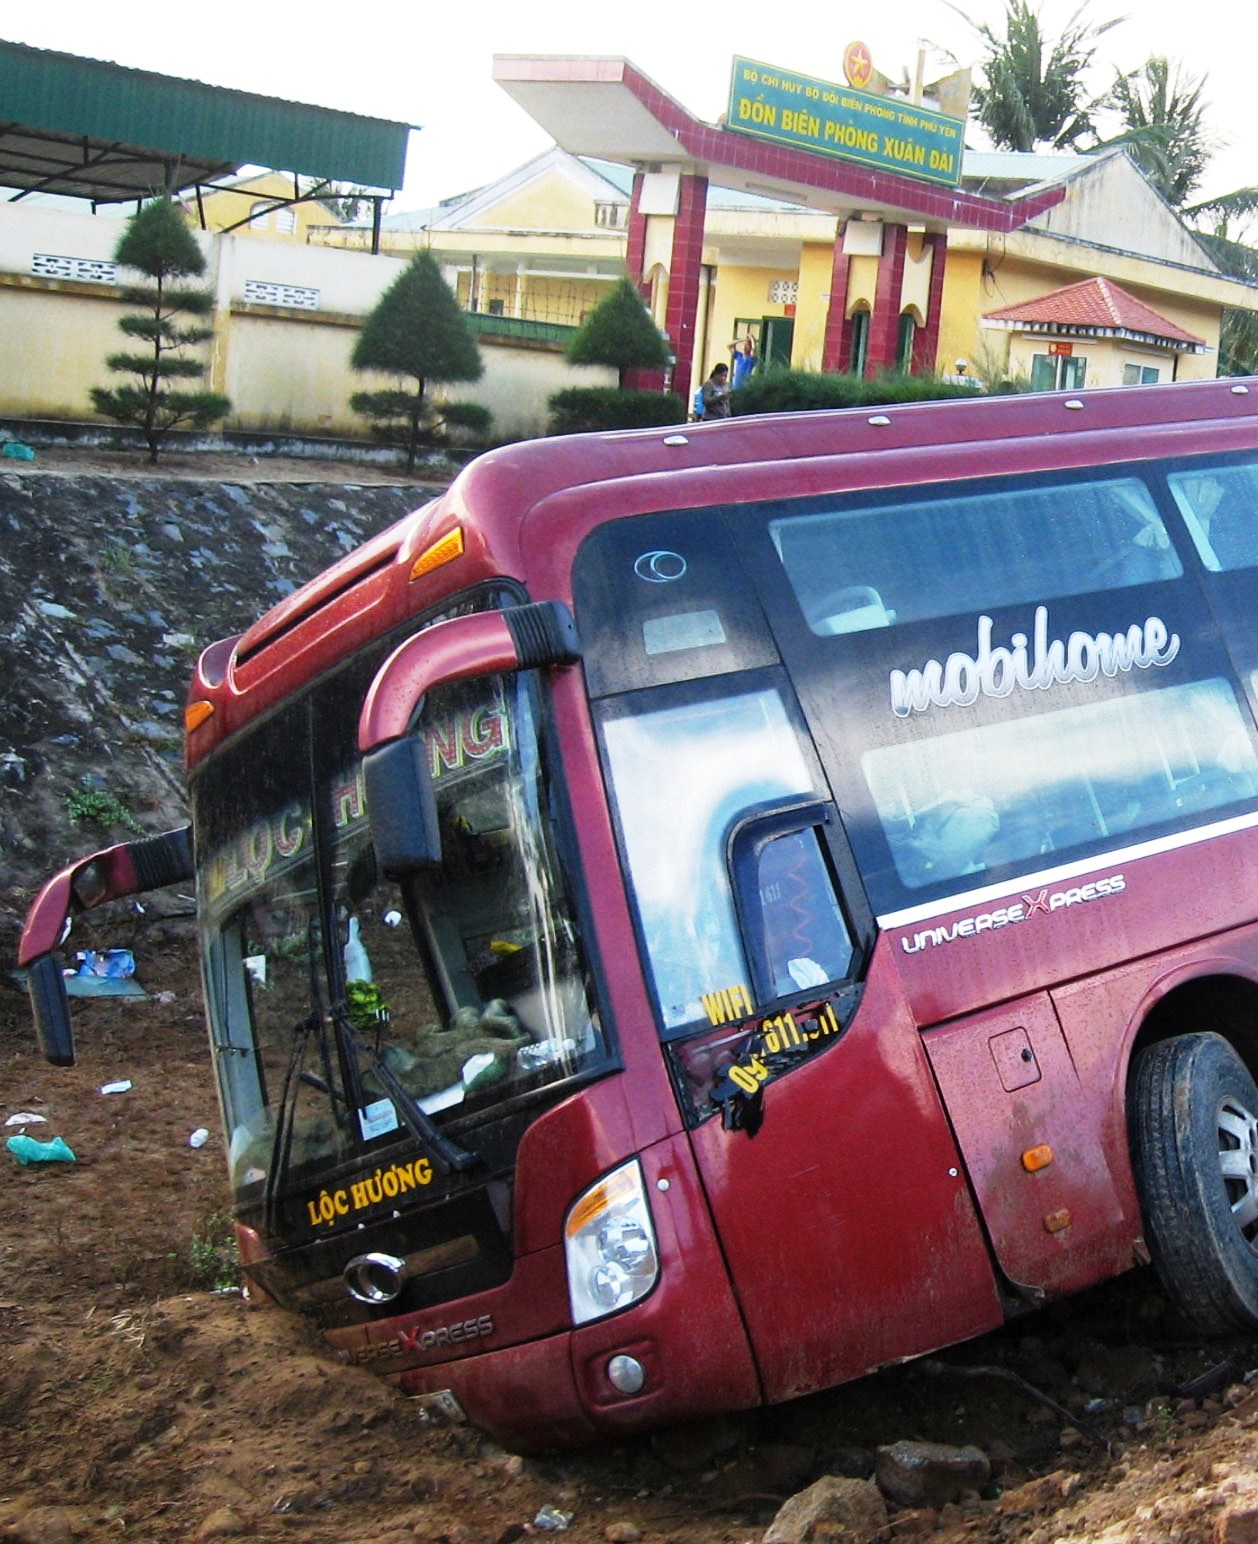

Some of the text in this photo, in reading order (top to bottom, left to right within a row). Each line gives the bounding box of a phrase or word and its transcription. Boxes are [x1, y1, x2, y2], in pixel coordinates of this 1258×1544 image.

[781, 79, 802, 94] HUY
[781, 108, 819, 138] BIÊN
[825, 119, 877, 153] PHÒNG
[884, 137, 925, 165] XUÂN
[889, 605, 1181, 718] mobihome
[701, 984, 754, 1027] WIFI
[308, 1157, 434, 1228] LỘC HƯƠNG
